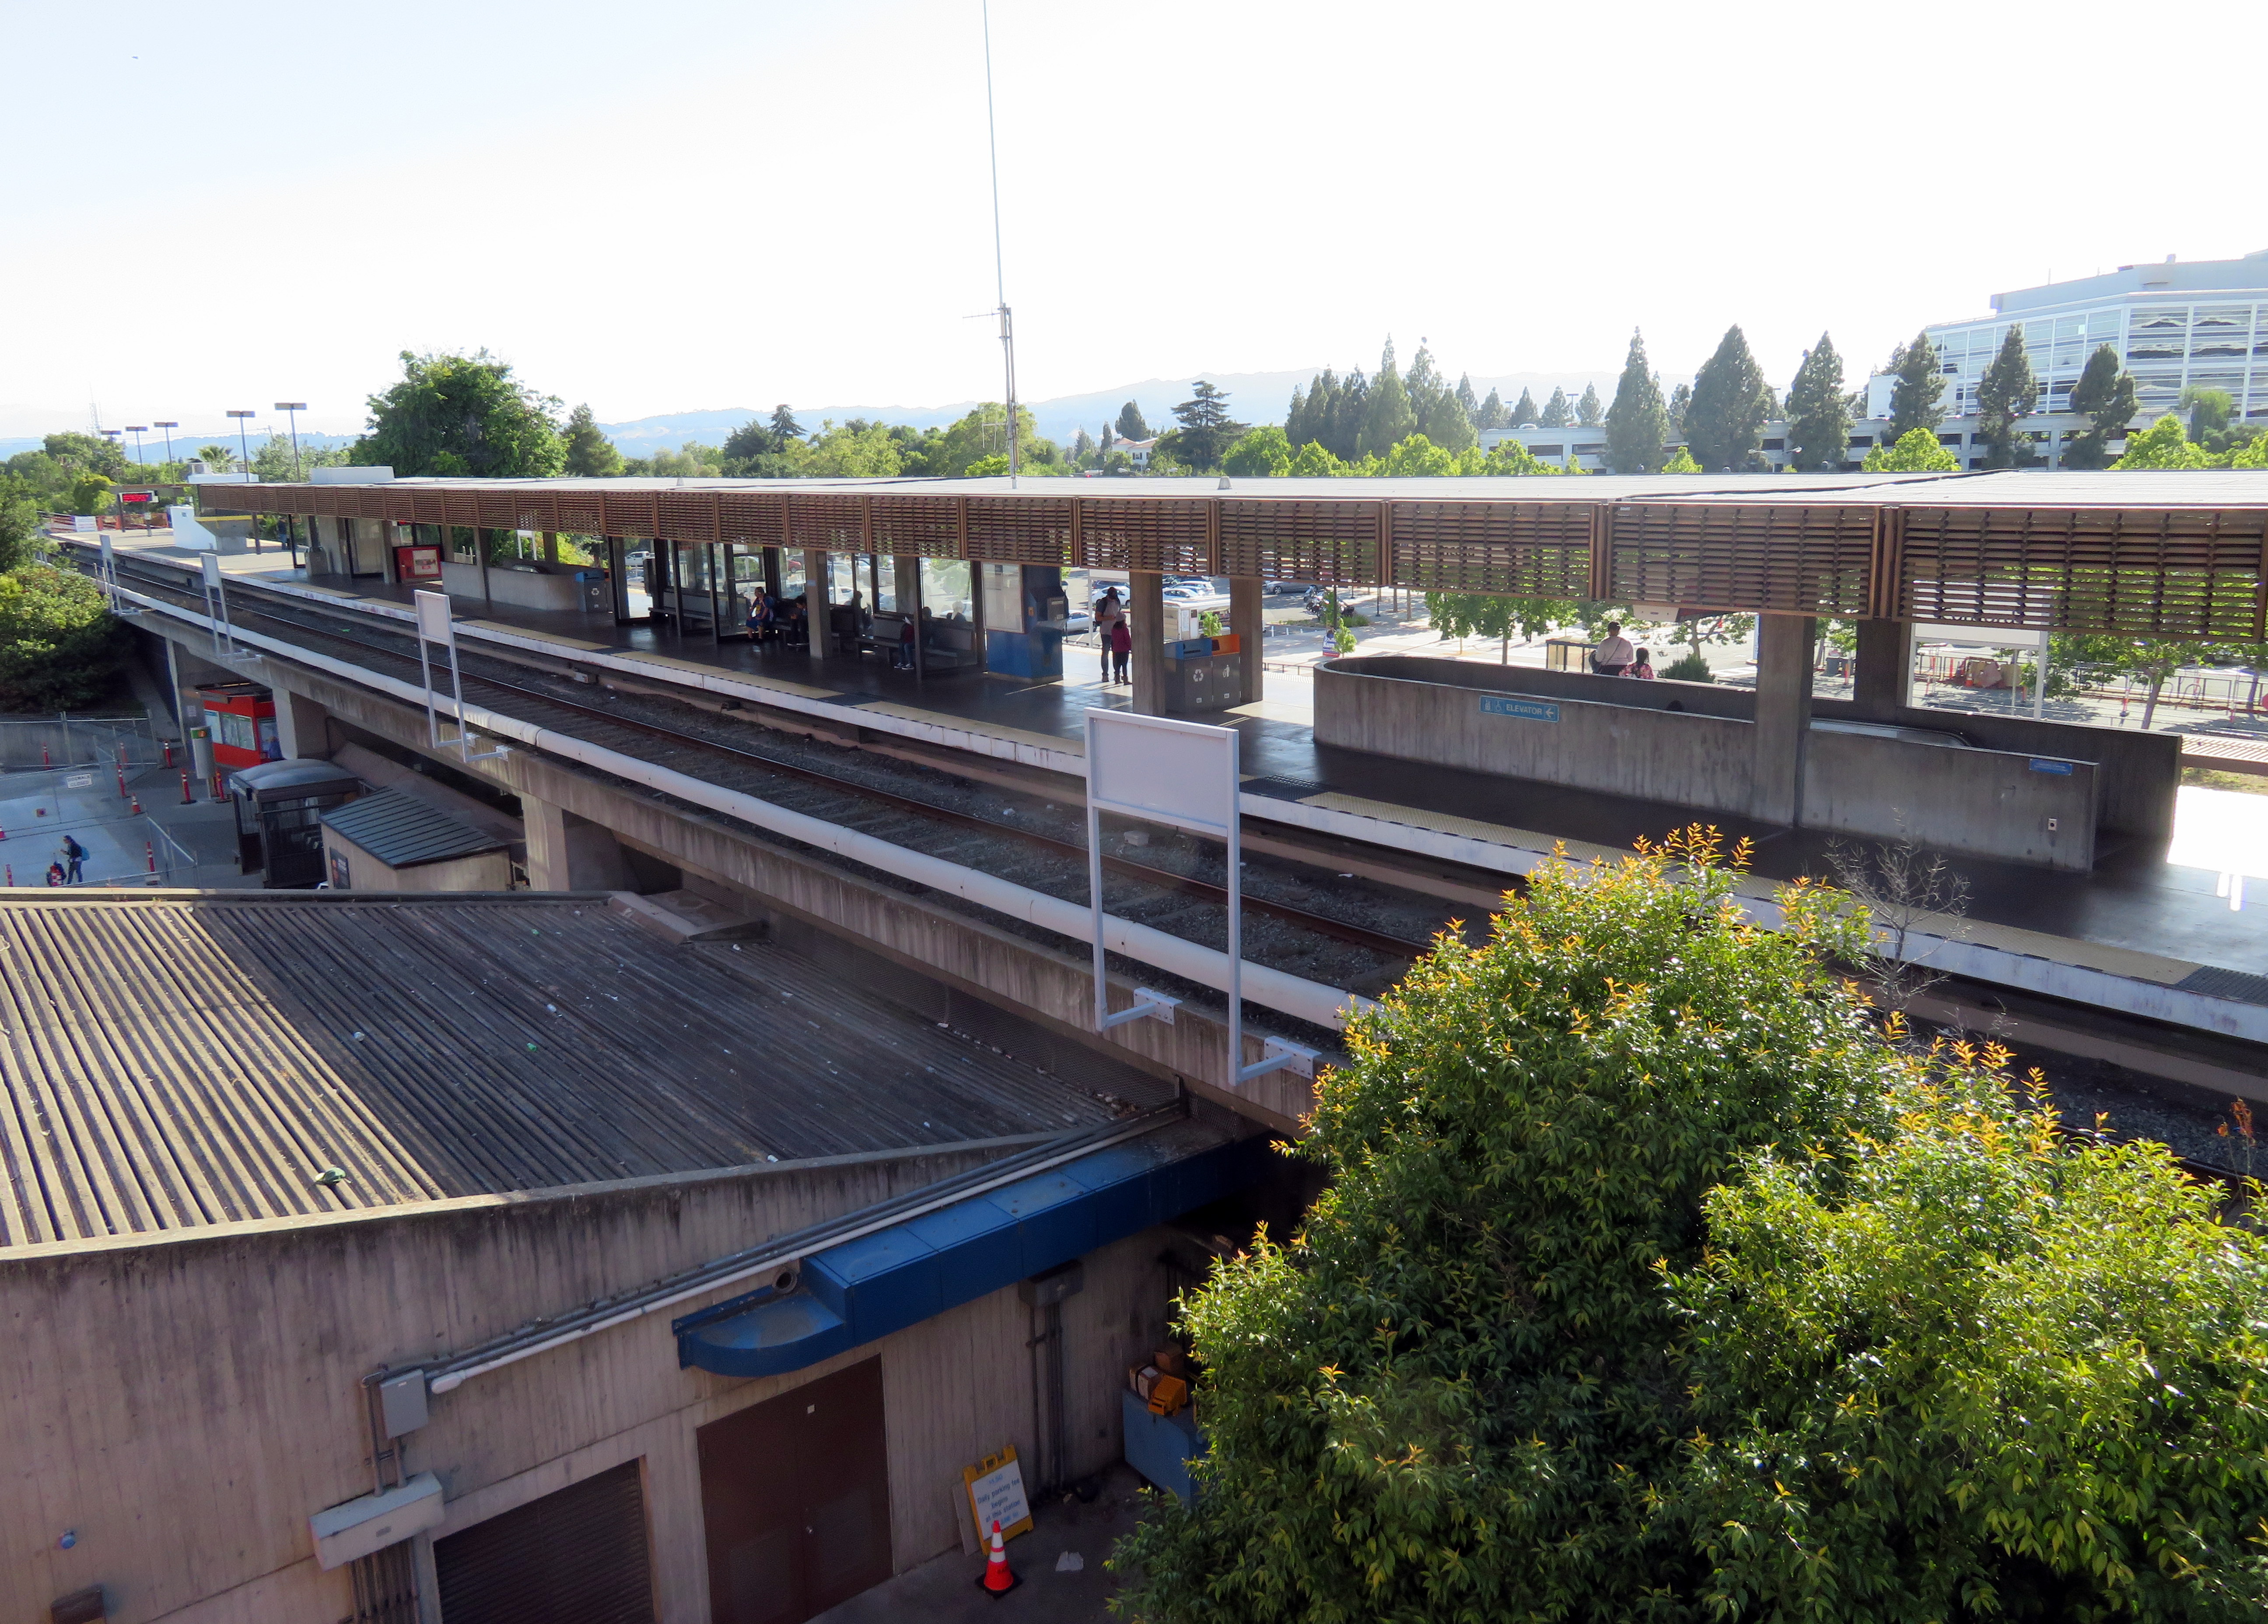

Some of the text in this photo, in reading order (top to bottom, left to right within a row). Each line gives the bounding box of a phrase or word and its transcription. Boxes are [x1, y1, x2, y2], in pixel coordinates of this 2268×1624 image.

[1506, 704, 1542, 715] ELEVATOR
[977, 1495, 990, 1504] Daily
[992, 1483, 1011, 1498] parking
[991, 1496, 1008, 1509] begins
[1004, 1500, 1021, 1512] station
